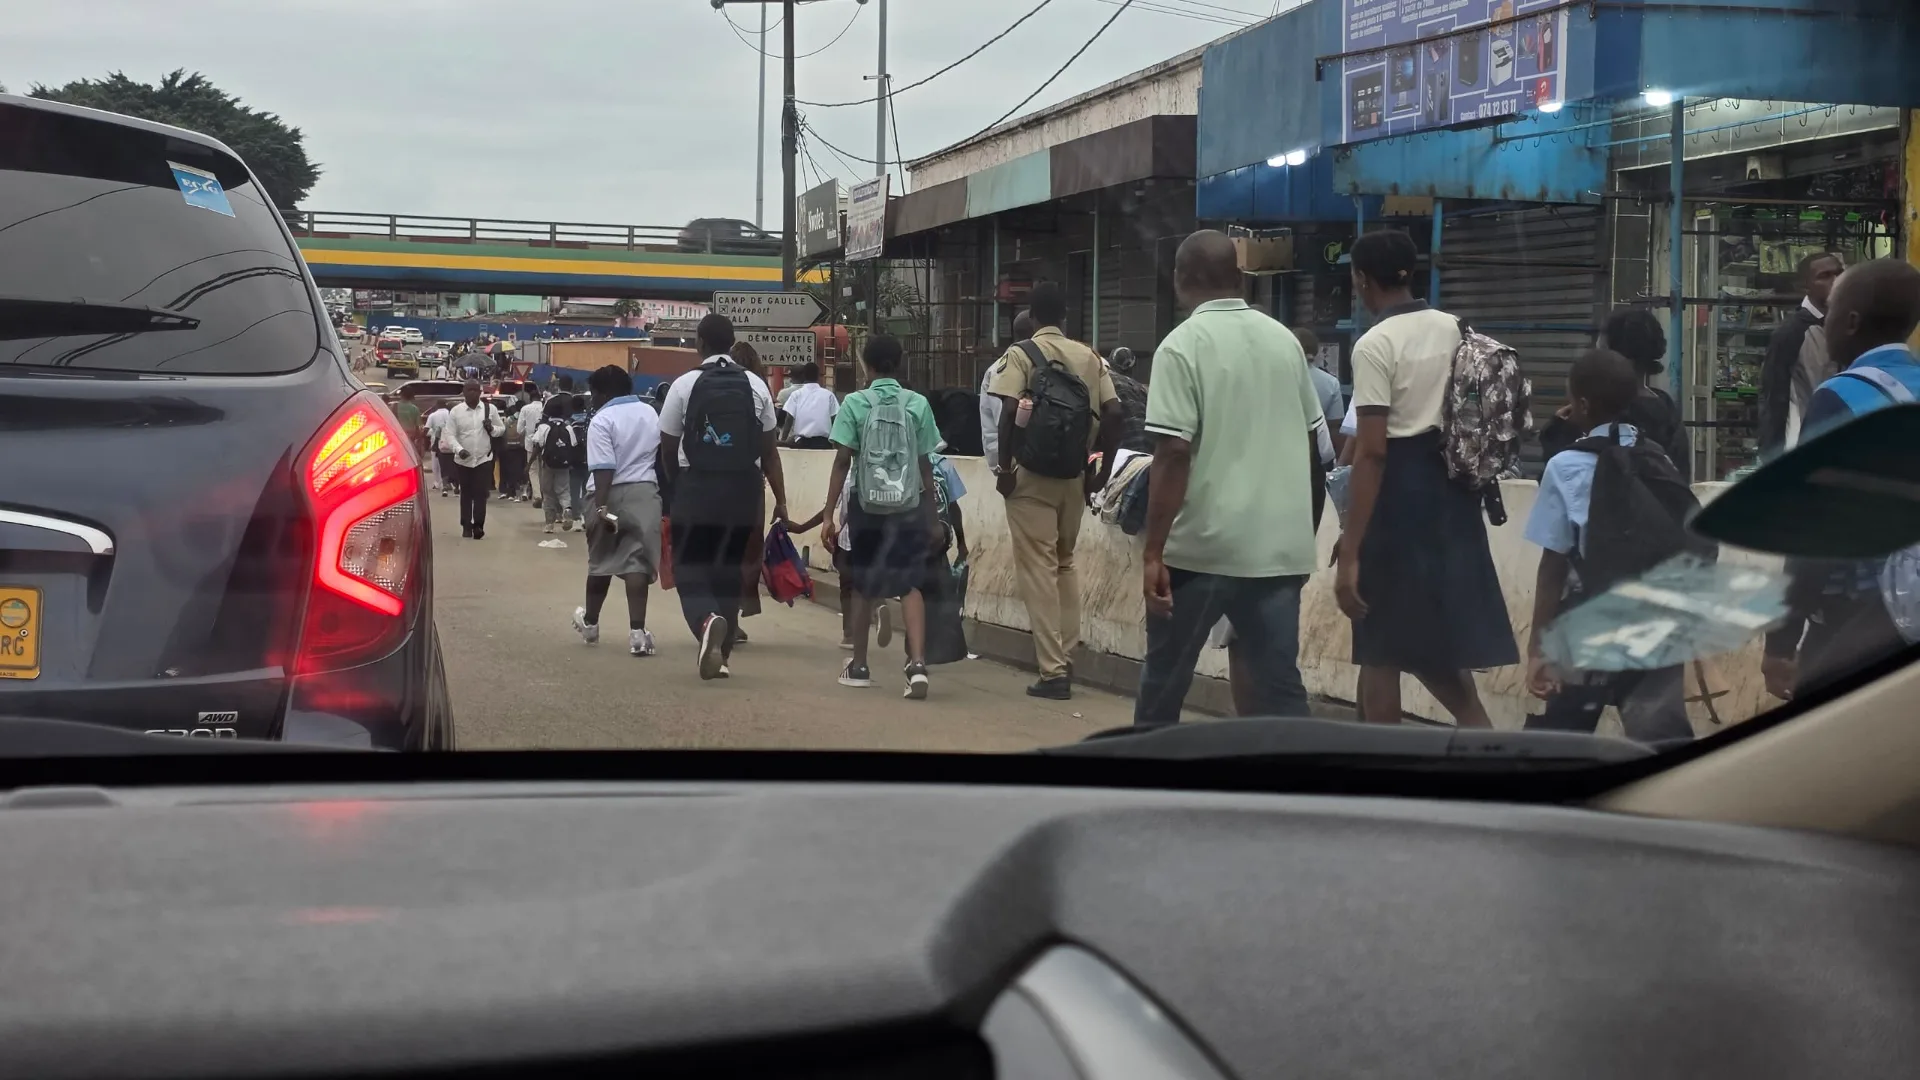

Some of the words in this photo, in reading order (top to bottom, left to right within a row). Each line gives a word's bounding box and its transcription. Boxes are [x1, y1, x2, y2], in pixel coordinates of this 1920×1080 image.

[1478, 102, 1491, 118] 074
[1492, 101, 1500, 116] 12
[1501, 100, 1509, 115] 13
[1510, 98, 1517, 113] 11
[718, 296, 746, 304] CAMP
[767, 297, 806, 305] GAULLE
[731, 306, 770, 314] Aéroport
[748, 334, 813, 343] DÉMOCRATIE
[869, 489, 902, 502] PUMA
[200, 713, 236, 722] AWD
